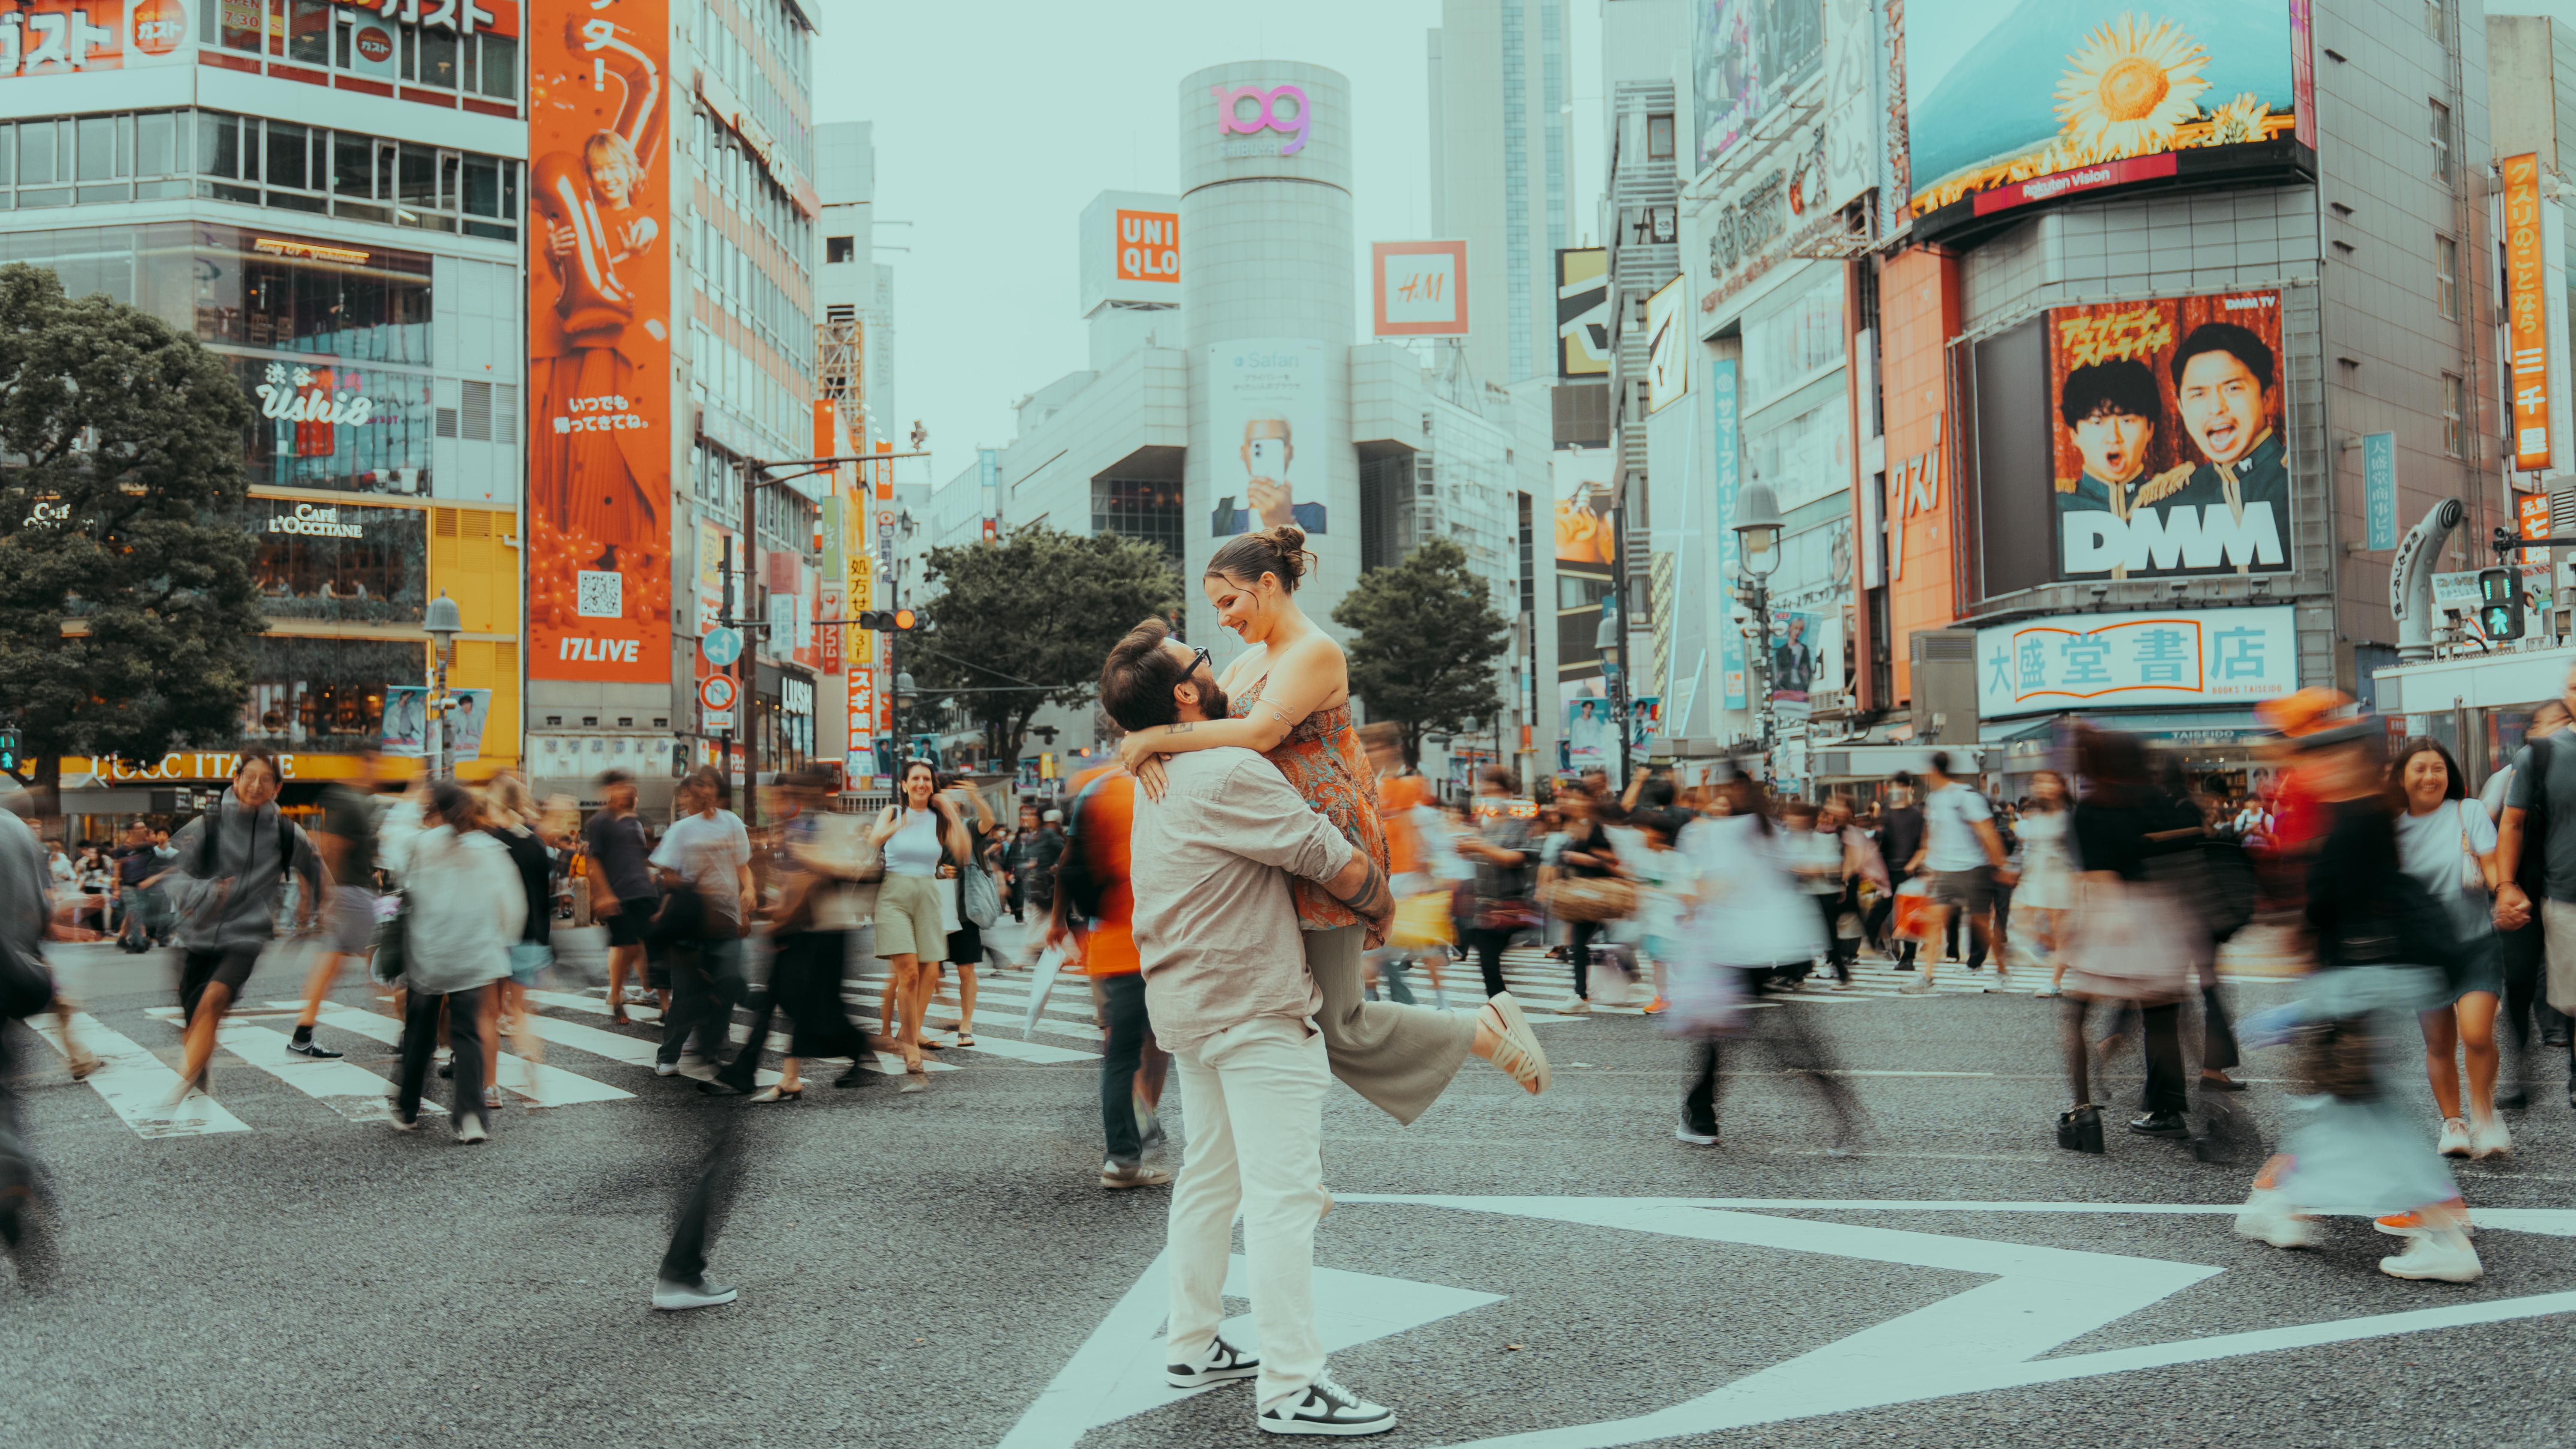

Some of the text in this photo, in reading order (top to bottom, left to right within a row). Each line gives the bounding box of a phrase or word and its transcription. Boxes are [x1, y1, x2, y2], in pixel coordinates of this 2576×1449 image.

[224, 0, 260, 9] EN
[138, 21, 183, 40] ガスト
[360, 41, 389, 54] ガスト
[1210, 85, 1310, 155] 109
[1220, 142, 1278, 156] SHIBUYA
[2023, 168, 2111, 198] Rakuten Vision
[1122, 217, 1173, 246] UNI
[1122, 247, 1179, 277] QLO
[2510, 162, 2537, 334] クスリのことなら
[1397, 272, 1445, 303] H&M
[2225, 296, 2276, 310] DMM TV
[2058, 306, 2162, 349] アップデート
[1248, 351, 1300, 368] Safari
[2070, 322, 2172, 370] ストライキ
[265, 363, 314, 387] 渋谷
[256, 383, 372, 427] Ushi8
[568, 394, 629, 413] いつでも
[2515, 346, 2549, 456] 三千里
[553, 414, 649, 434] 帰ってきてね。
[1715, 397, 1737, 562] サマーフルーツギフ
[2370, 440, 2390, 545] 大盛堂商事ビル
[268, 515, 363, 538] L'OCCITANE
[2063, 501, 2284, 574] DMM
[559, 637, 640, 663] 17LIVE
[825, 625, 838, 658] アコム
[855, 634, 865, 659] 3F
[1989, 626, 2266, 695] 大盛堂書店
[782, 676, 813, 716] LUSH
[2211, 683, 2282, 695] BOOKS TAISEIDO
[850, 671, 871, 748] スギ薬局
[2172, 730, 2235, 739] TAISEIDO
[91, 752, 296, 779] L'OCITAE
